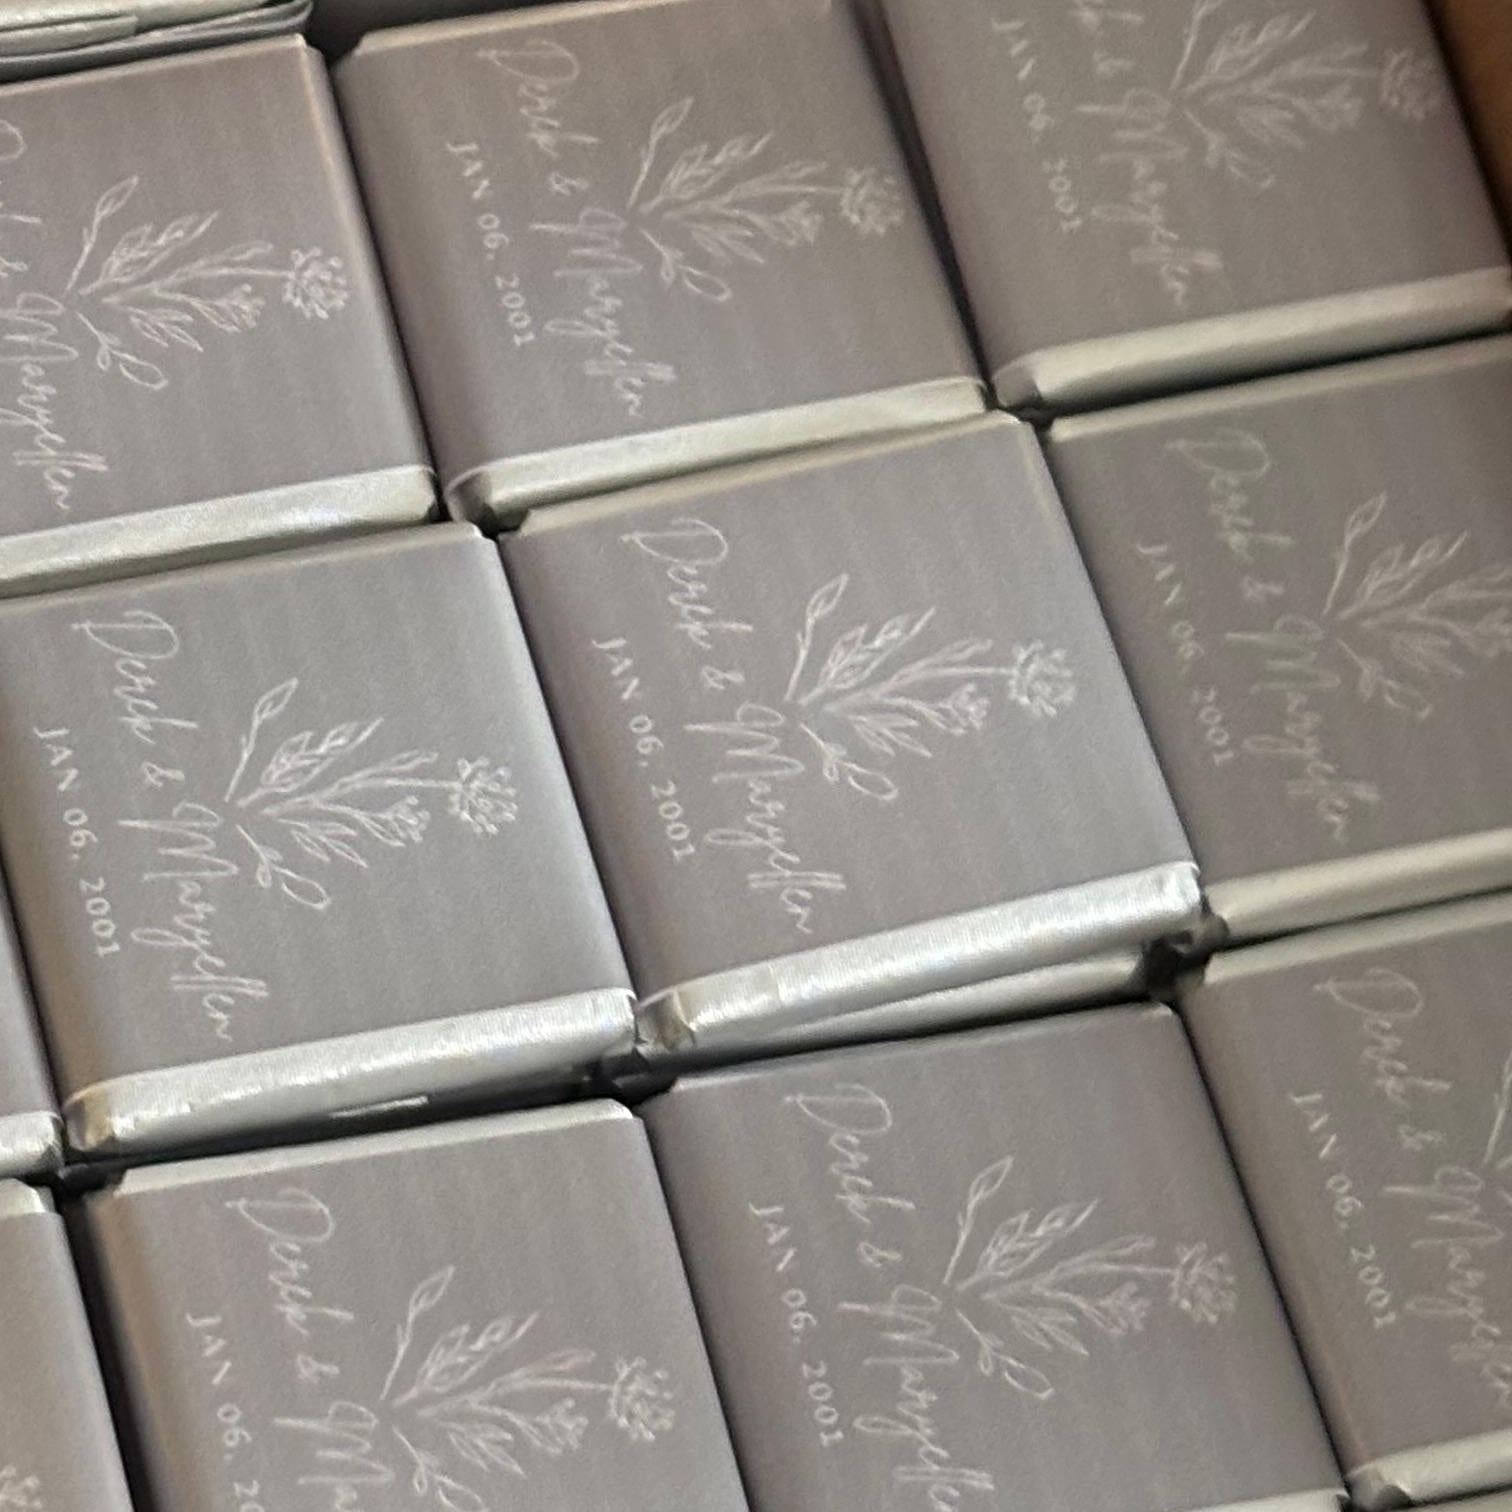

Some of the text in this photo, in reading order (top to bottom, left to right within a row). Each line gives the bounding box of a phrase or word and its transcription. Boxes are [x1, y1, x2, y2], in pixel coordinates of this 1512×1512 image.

[495, 273, 536, 347] 2001
[34, 727, 78, 790] JAN
[79, 876, 120, 957] 2001
[591, 638, 640, 700] JAN
[651, 780, 696, 862] 2001
[186, 1314, 231, 1385] JAN
[748, 1203, 796, 1272] JAN
[801, 1360, 843, 1447] 2001
